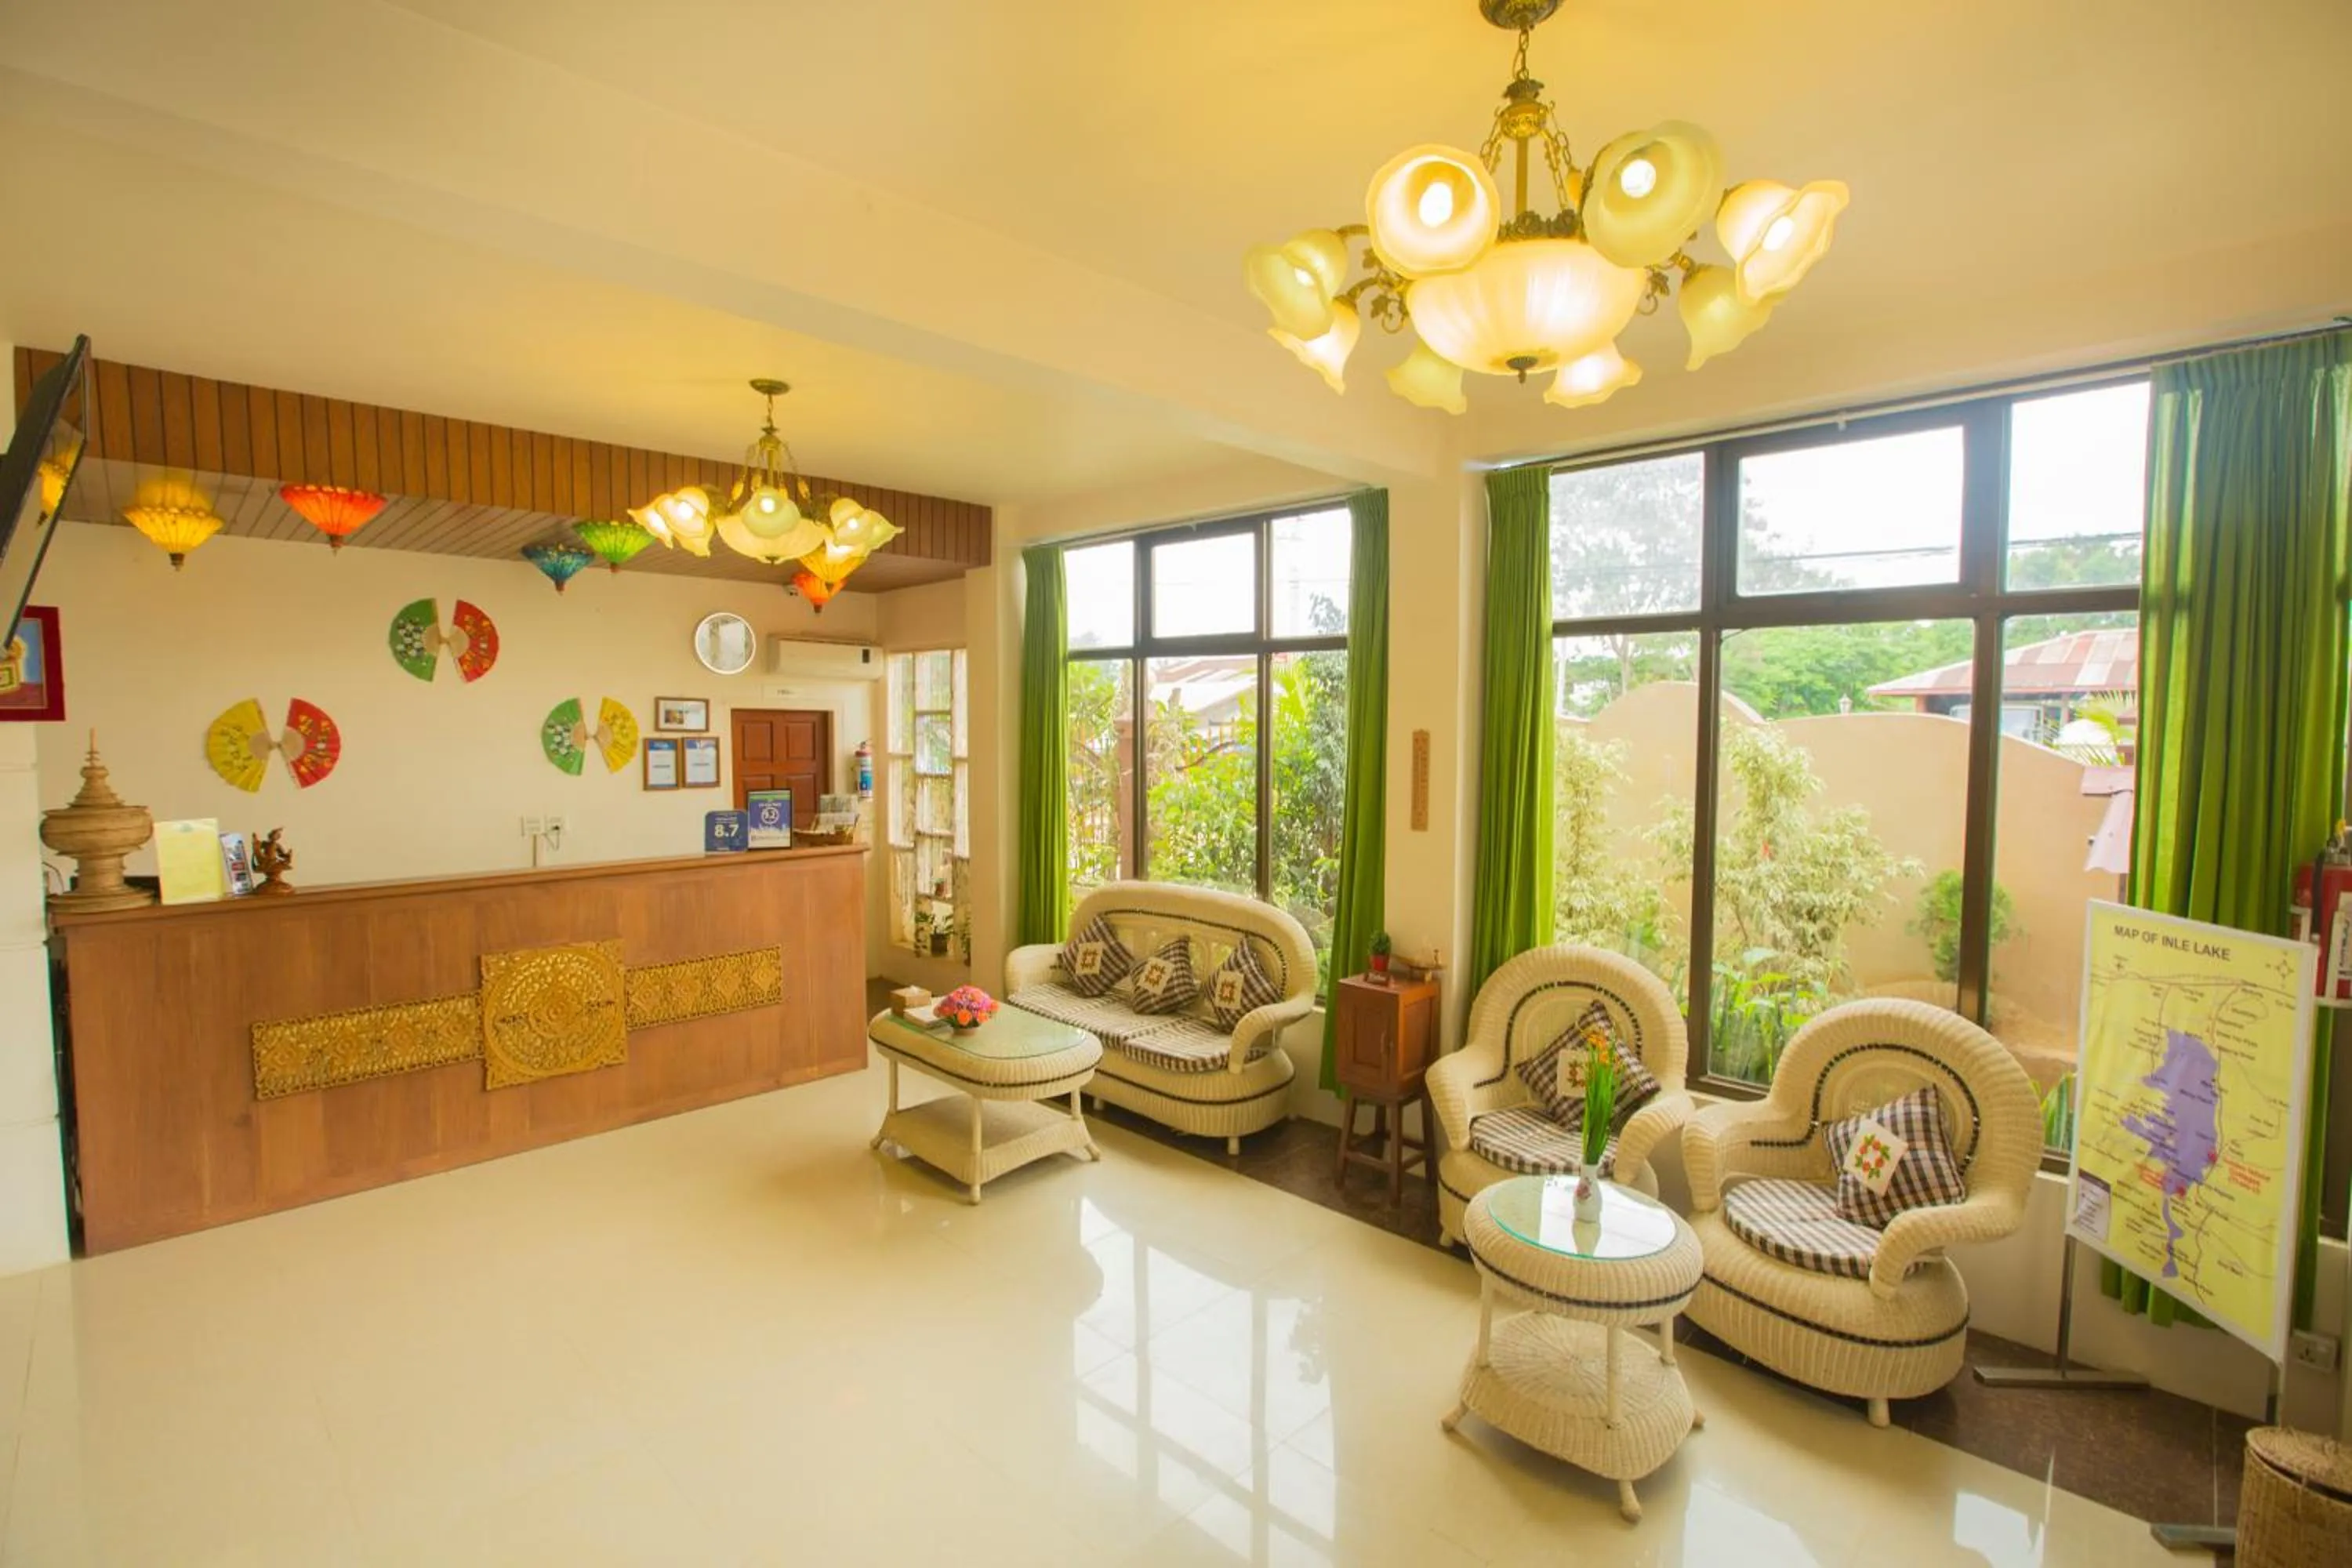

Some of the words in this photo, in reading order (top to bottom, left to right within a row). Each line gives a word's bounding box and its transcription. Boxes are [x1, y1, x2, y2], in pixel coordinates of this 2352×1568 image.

[714, 823, 739, 838] 8.7
[2114, 925, 2140, 939] MAP
[2141, 931, 2158, 944] OF
[2161, 935, 2190, 952] INLE
[2193, 942, 2231, 961] LAKE
